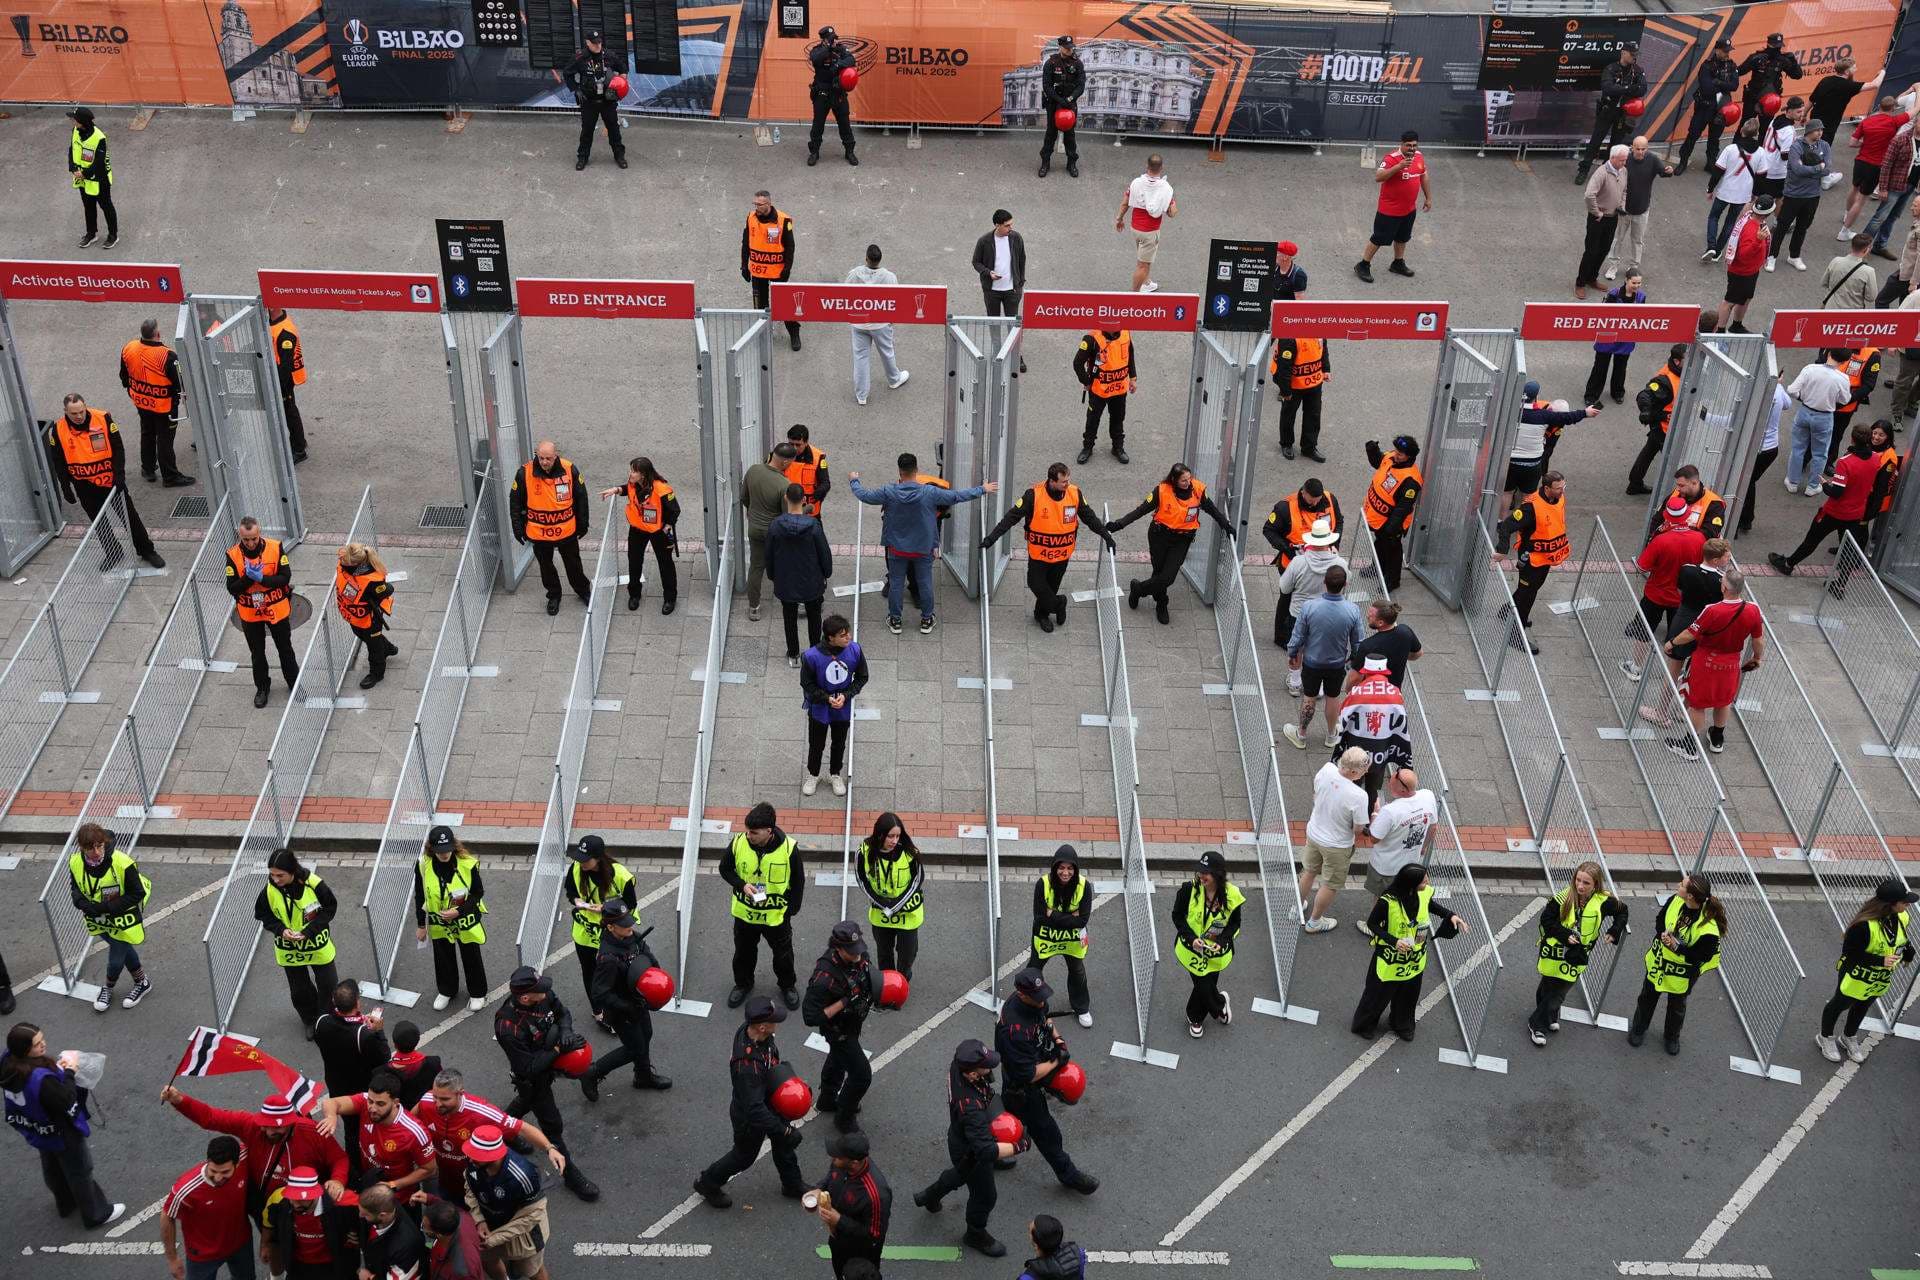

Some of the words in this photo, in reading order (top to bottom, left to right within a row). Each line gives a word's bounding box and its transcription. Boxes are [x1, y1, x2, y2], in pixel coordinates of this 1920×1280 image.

[55, 45, 89, 53] FINAL
[92, 45, 120, 54] 2025
[392, 50, 424, 59] FINAL
[427, 50, 455, 59] 2025
[896, 67, 927, 76] FINAL
[930, 67, 957, 77] 2025
[1296, 53, 1424, 85] #FOOTBALL
[1343, 94, 1387, 104] RESPECT
[12, 274, 74, 287] Activate
[78, 275, 151, 289] Bluetooth
[273, 286, 293, 295] Open
[295, 286, 308, 294] the
[358, 288, 385, 296] Tickets
[386, 289, 403, 297] App.
[549, 293, 579, 305] RED
[583, 294, 667, 307] ENTRANCE
[820, 298, 896, 311] WELCOME
[1035, 304, 1094, 317] Activate
[1098, 305, 1167, 318] Bluetooth
[1283, 316, 1303, 324] Open
[1304, 316, 1317, 324] the
[1338, 317, 1363, 325] Mobile
[1365, 317, 1390, 325] Tickets
[1392, 318, 1408, 326] App.
[1553, 317, 1583, 329] RED
[1586, 318, 1670, 330] ENTRANCE
[1822, 323, 1898, 336] WELCOME
[68, 460, 113, 476] STEWAR
[540, 526, 562, 538] 109
[1028, 532, 1074, 546] STEWAR
[1040, 549, 1068, 560] 4624
[745, 909, 767, 922] 371
[881, 912, 906, 925] 301
[275, 928, 329, 950] TEWARD
[1040, 925, 1081, 941] EWAR
[285, 952, 313, 964] 297
